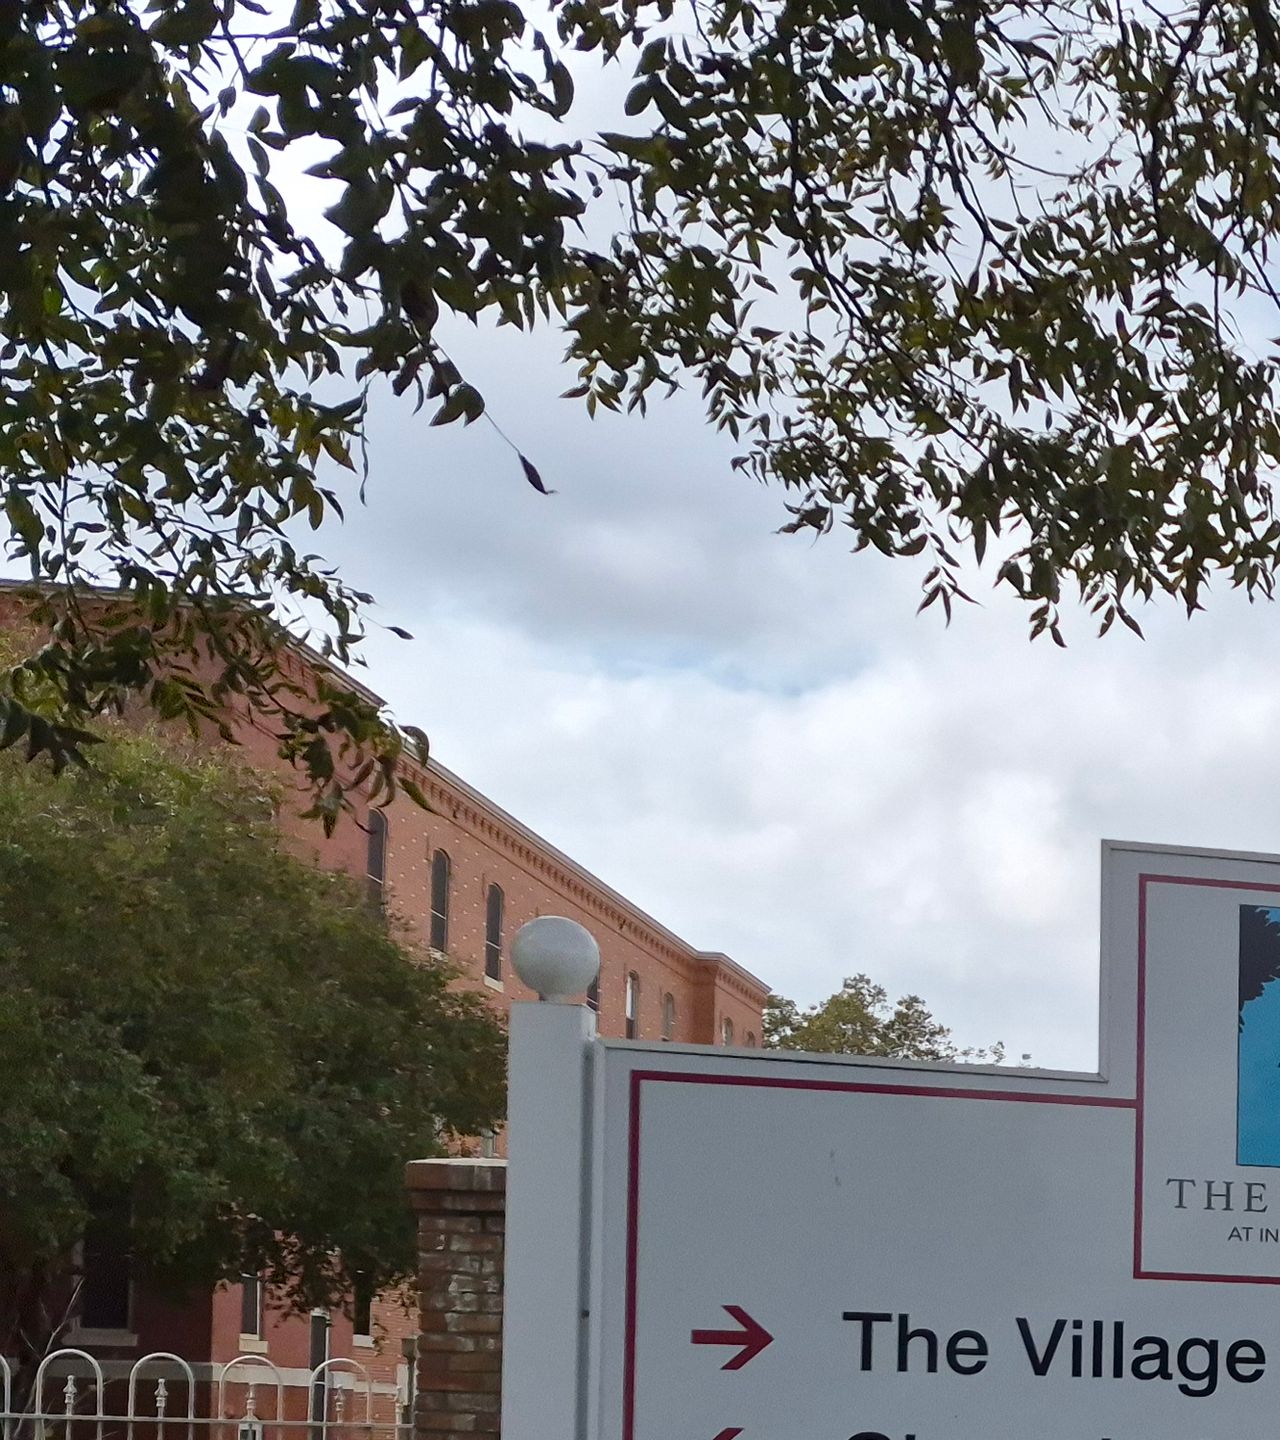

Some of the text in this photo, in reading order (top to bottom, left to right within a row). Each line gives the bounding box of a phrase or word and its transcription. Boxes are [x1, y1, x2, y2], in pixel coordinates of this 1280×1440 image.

[1166, 1178, 1268, 1213] THE
[1227, 1226, 1254, 1242] AT
[842, 1311, 989, 1376] The
[1015, 1317, 1266, 1398] Village
